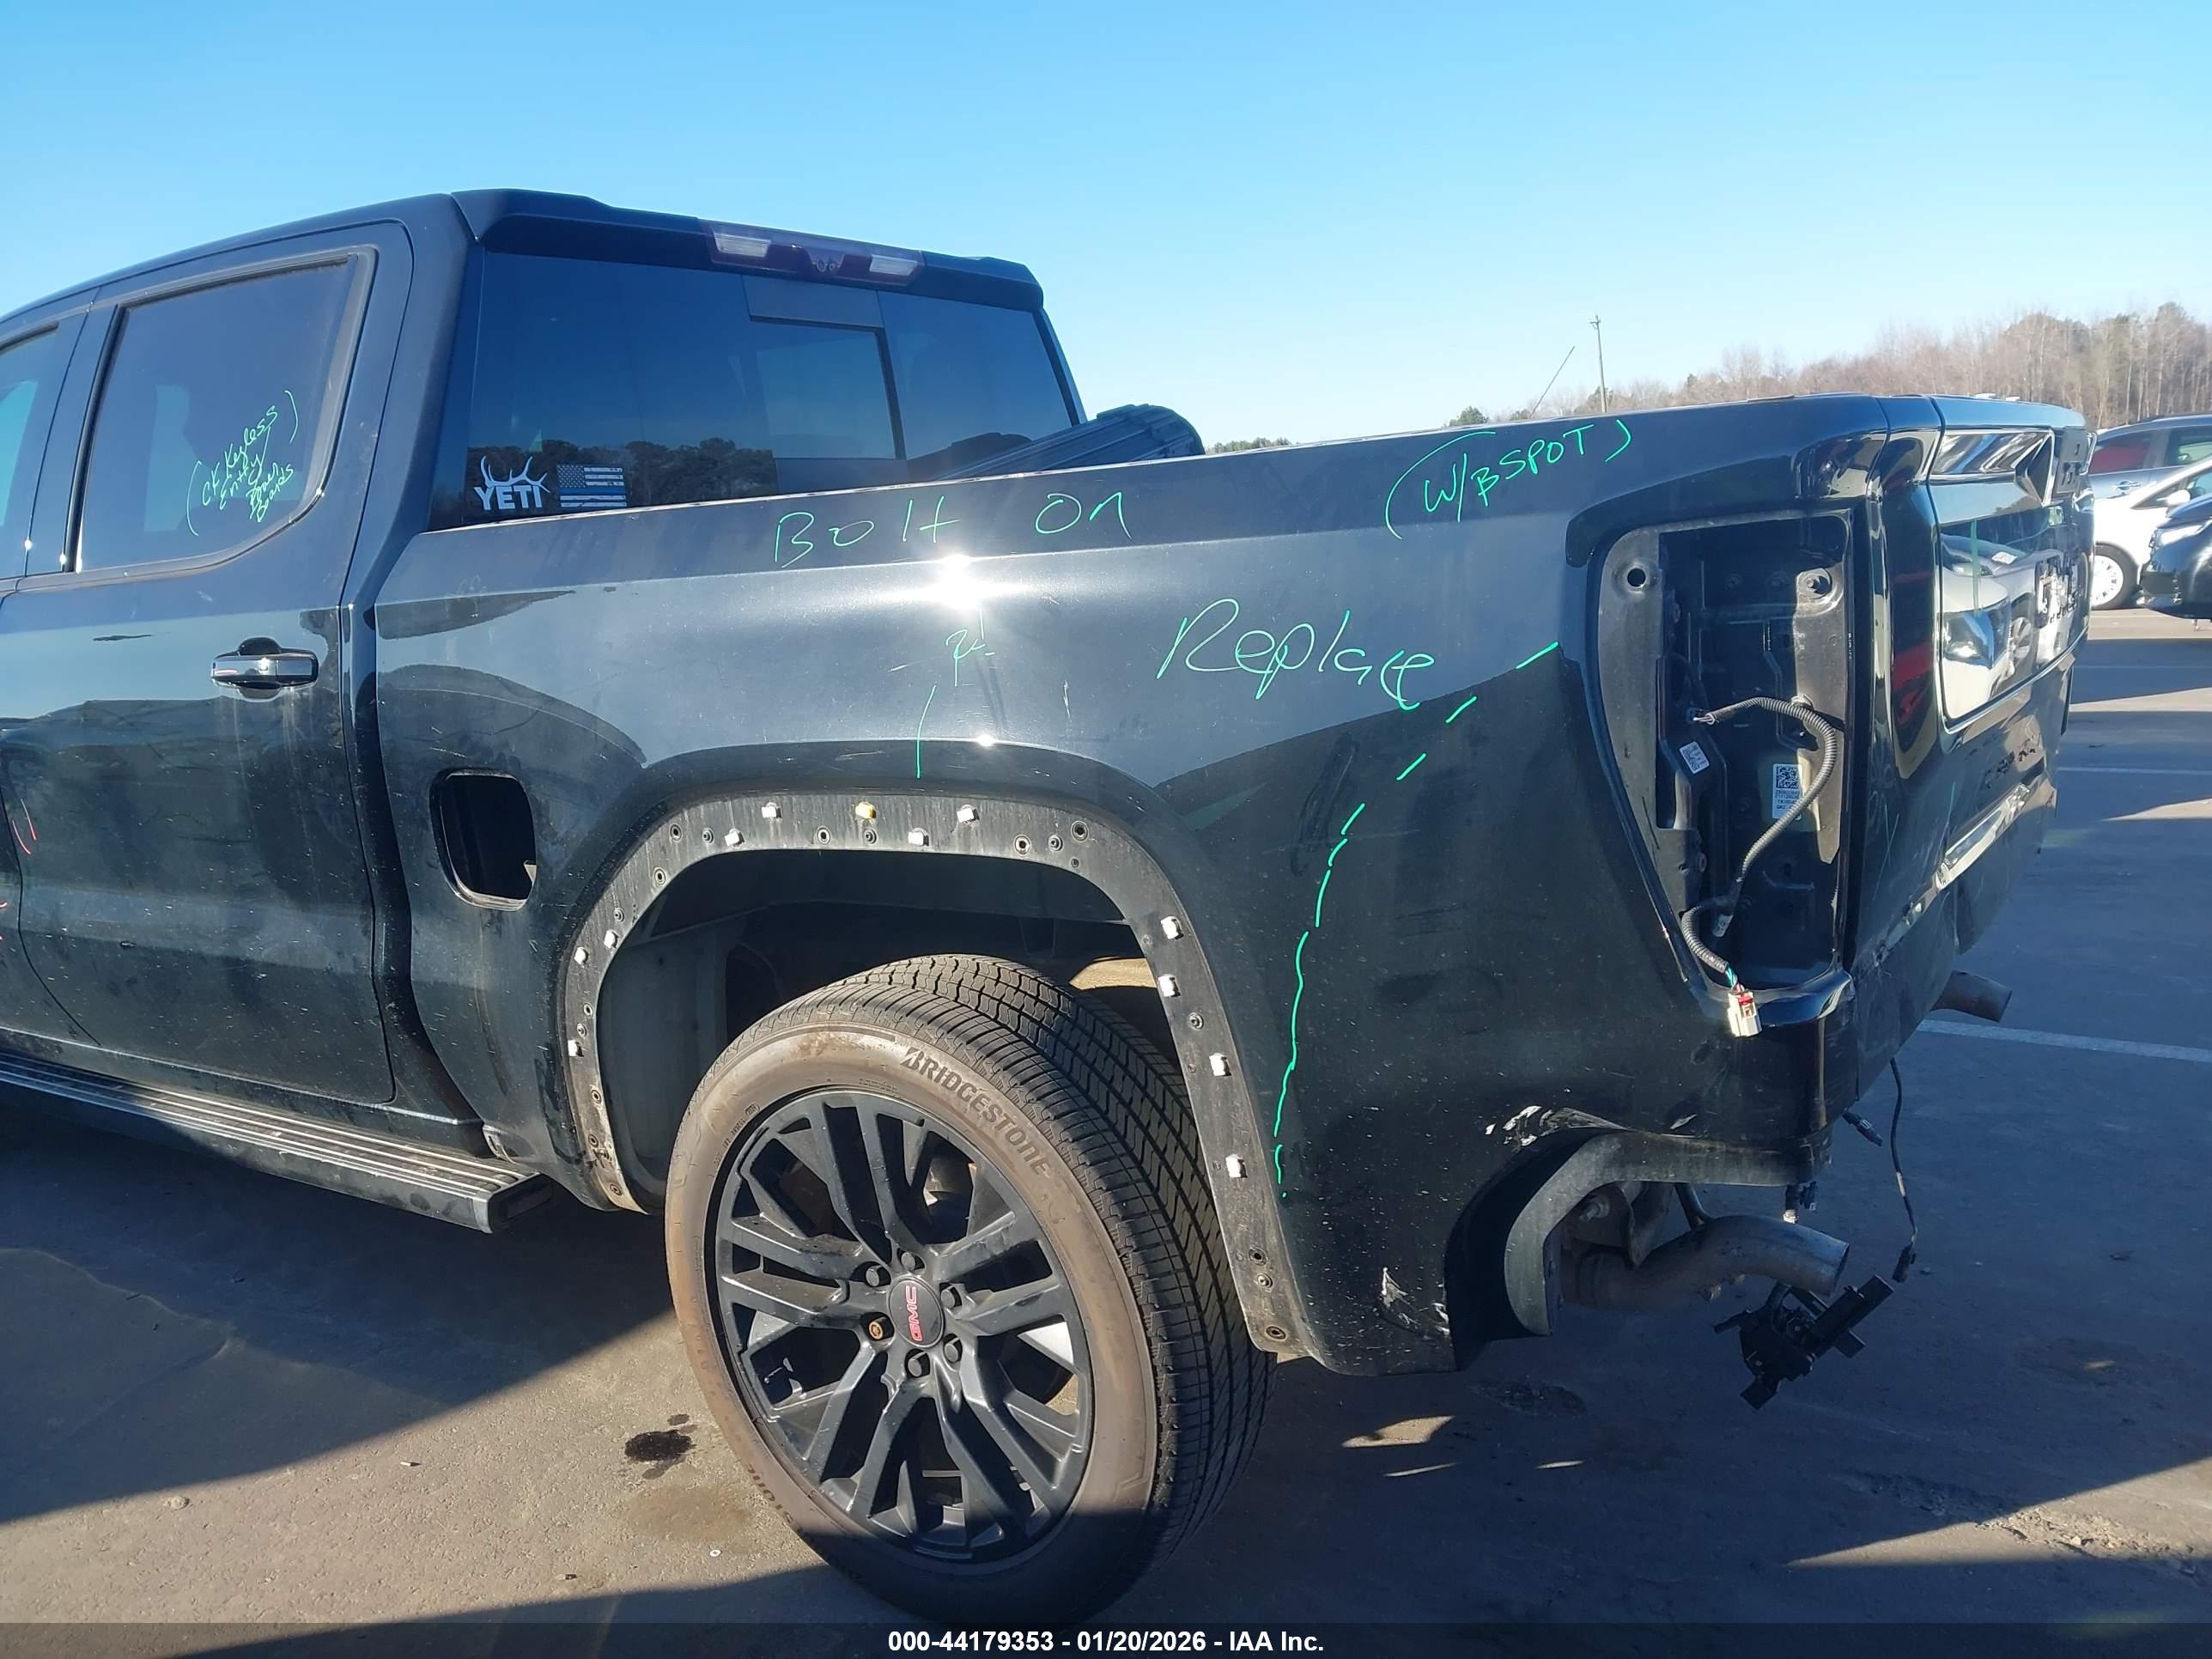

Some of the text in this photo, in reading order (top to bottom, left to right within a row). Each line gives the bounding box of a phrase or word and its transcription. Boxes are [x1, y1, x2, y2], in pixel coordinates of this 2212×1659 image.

[474, 484, 543, 510] YETI
[1157, 599, 1435, 710] Replace
[900, 1046, 1051, 1177] BRIDGESTONE
[906, 1285, 923, 1341] GMC
